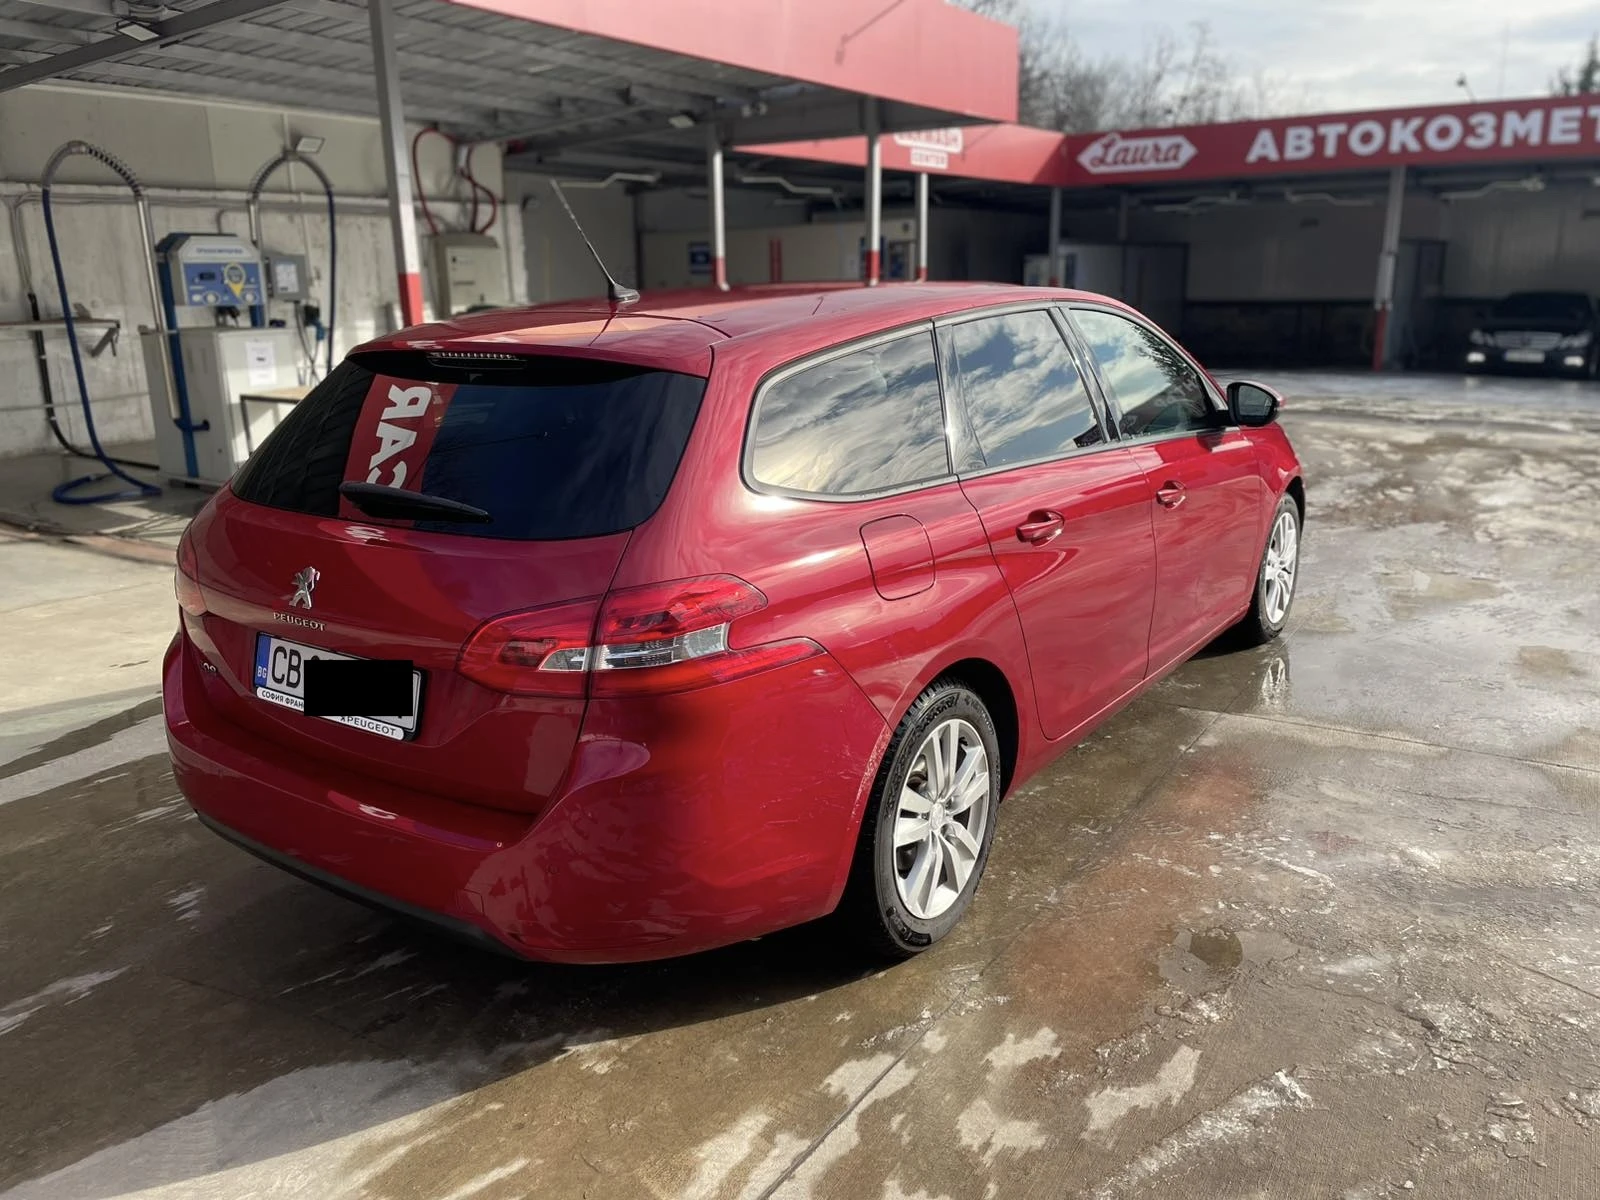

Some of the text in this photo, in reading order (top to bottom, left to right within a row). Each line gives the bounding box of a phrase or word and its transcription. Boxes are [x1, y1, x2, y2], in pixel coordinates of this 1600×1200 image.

[1090, 137, 1182, 168] Laura
[273, 611, 326, 632] PEUGEOT
[257, 665, 267, 679] BG
[261, 689, 304, 710] СОФИЯ ФРАН
[347, 717, 396, 736] PEUGEOT
